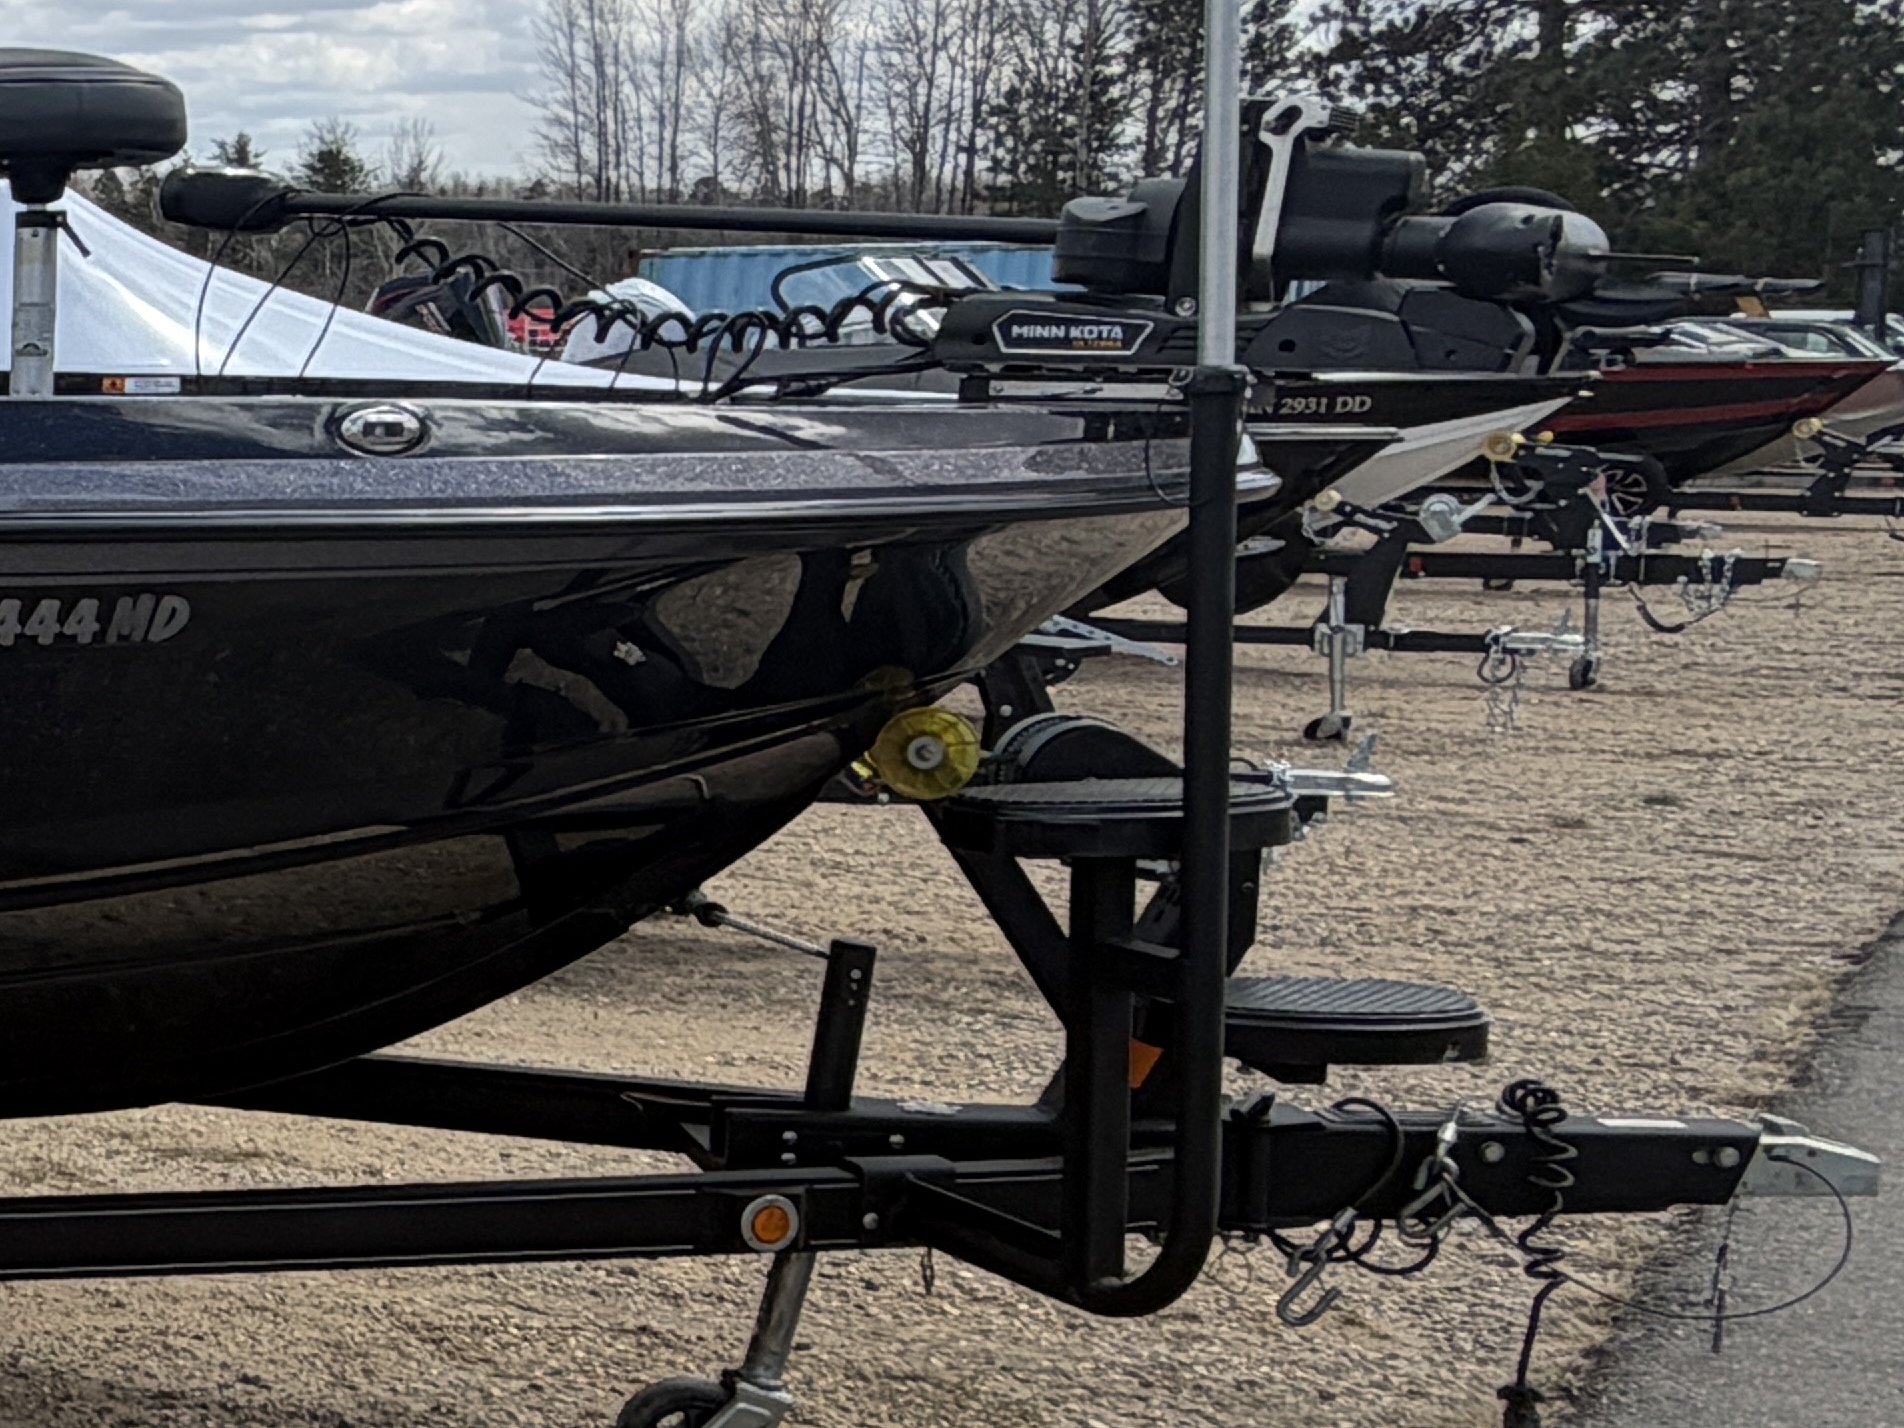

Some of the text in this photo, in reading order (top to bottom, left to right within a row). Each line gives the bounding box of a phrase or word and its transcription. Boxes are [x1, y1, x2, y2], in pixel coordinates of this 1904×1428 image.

[1011, 324, 1123, 340] MINN KOTA
[1277, 396, 1329, 414] 2931
[1334, 395, 1373, 414] DD
